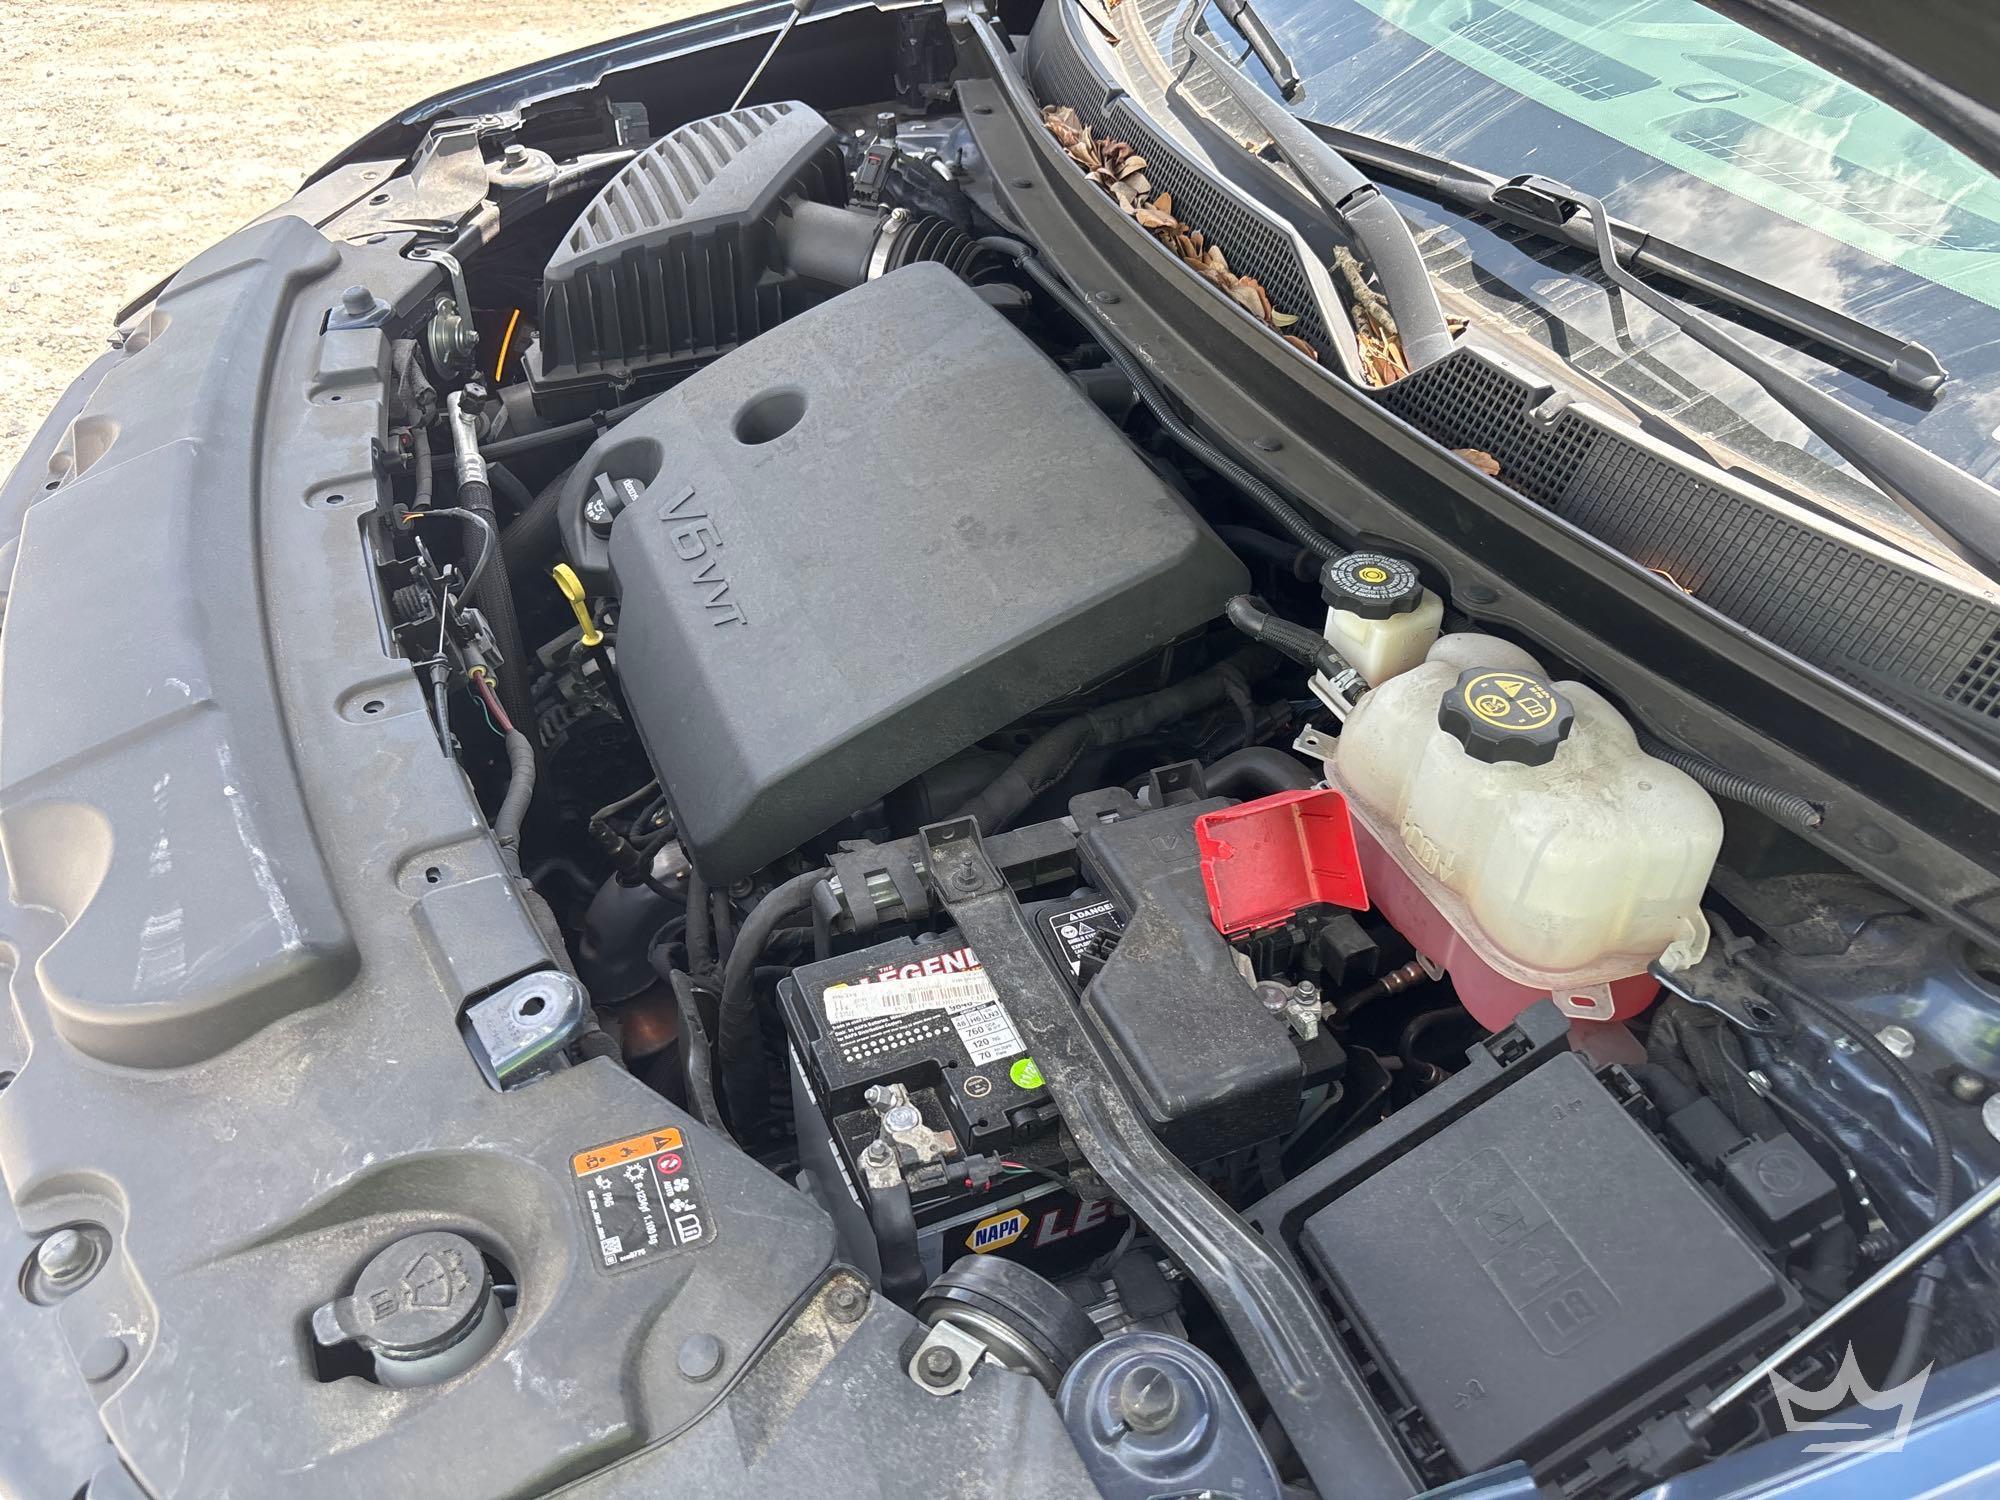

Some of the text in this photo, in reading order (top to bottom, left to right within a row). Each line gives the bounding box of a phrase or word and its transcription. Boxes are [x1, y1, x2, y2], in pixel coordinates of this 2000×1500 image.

[1077, 902, 1114, 919] DANGE
[1084, 932, 1097, 940] EYE
[970, 1015, 981, 1023] H6
[984, 1010, 999, 1020] LN3
[965, 1026, 984, 1037] 760
[973, 1038, 989, 1048] 120
[978, 1050, 991, 1060] 70
[1033, 1199, 1112, 1249] LE
[975, 1217, 1019, 1247] NAPA
[648, 1233, 659, 1245] kg
